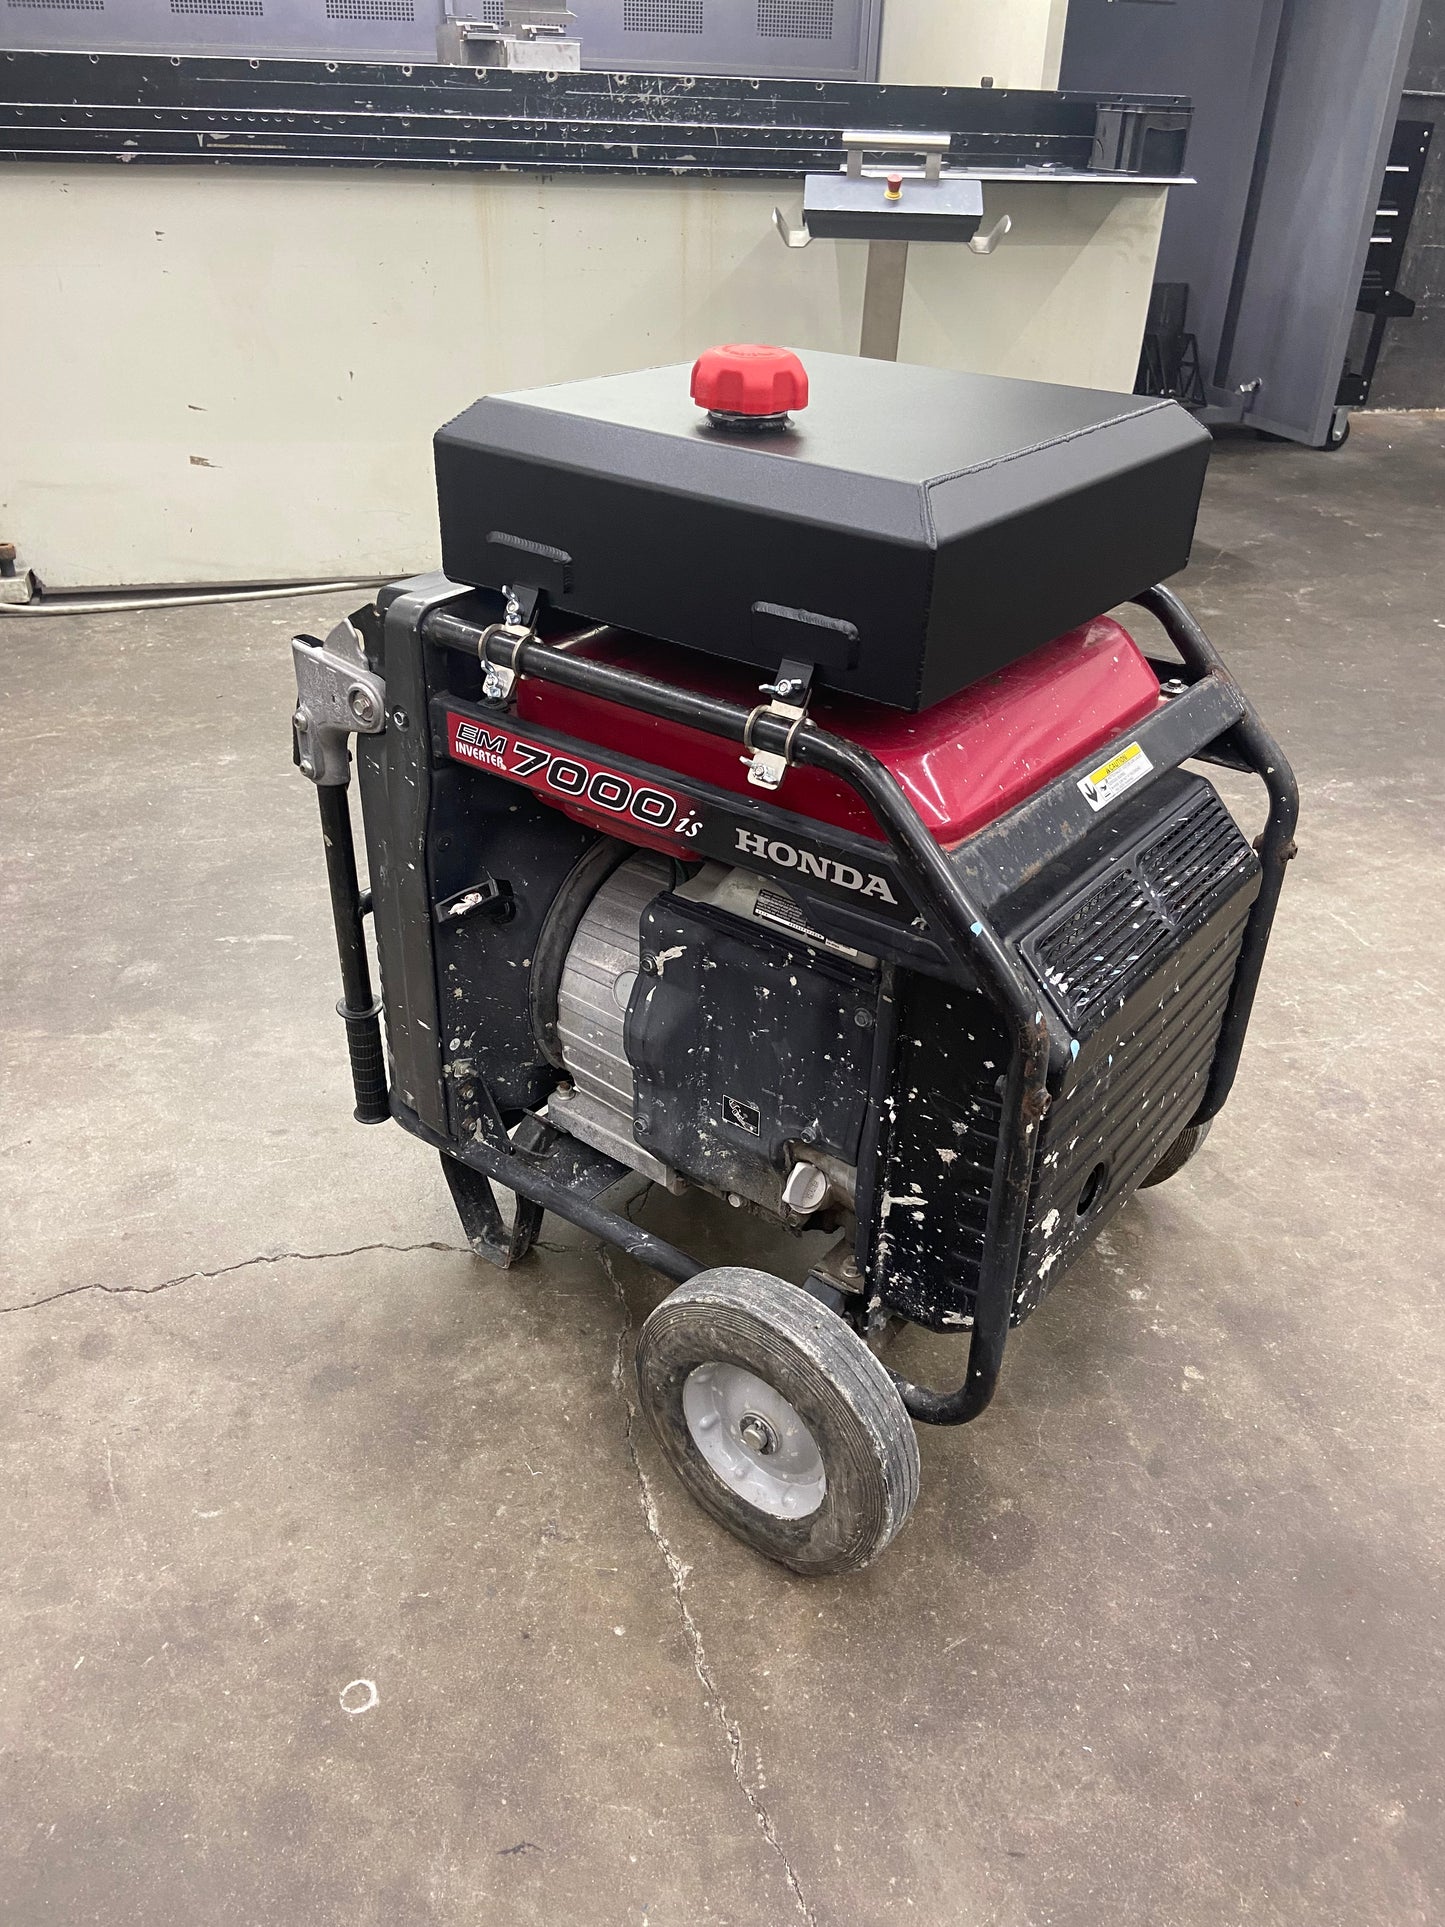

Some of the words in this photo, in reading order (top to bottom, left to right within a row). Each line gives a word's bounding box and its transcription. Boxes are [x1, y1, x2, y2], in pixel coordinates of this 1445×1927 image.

[456, 721, 508, 754] EM
[455, 741, 506, 769] INVERTER
[1108, 754, 1128, 771] CAUTION
[735, 827, 898, 905] HONDA
